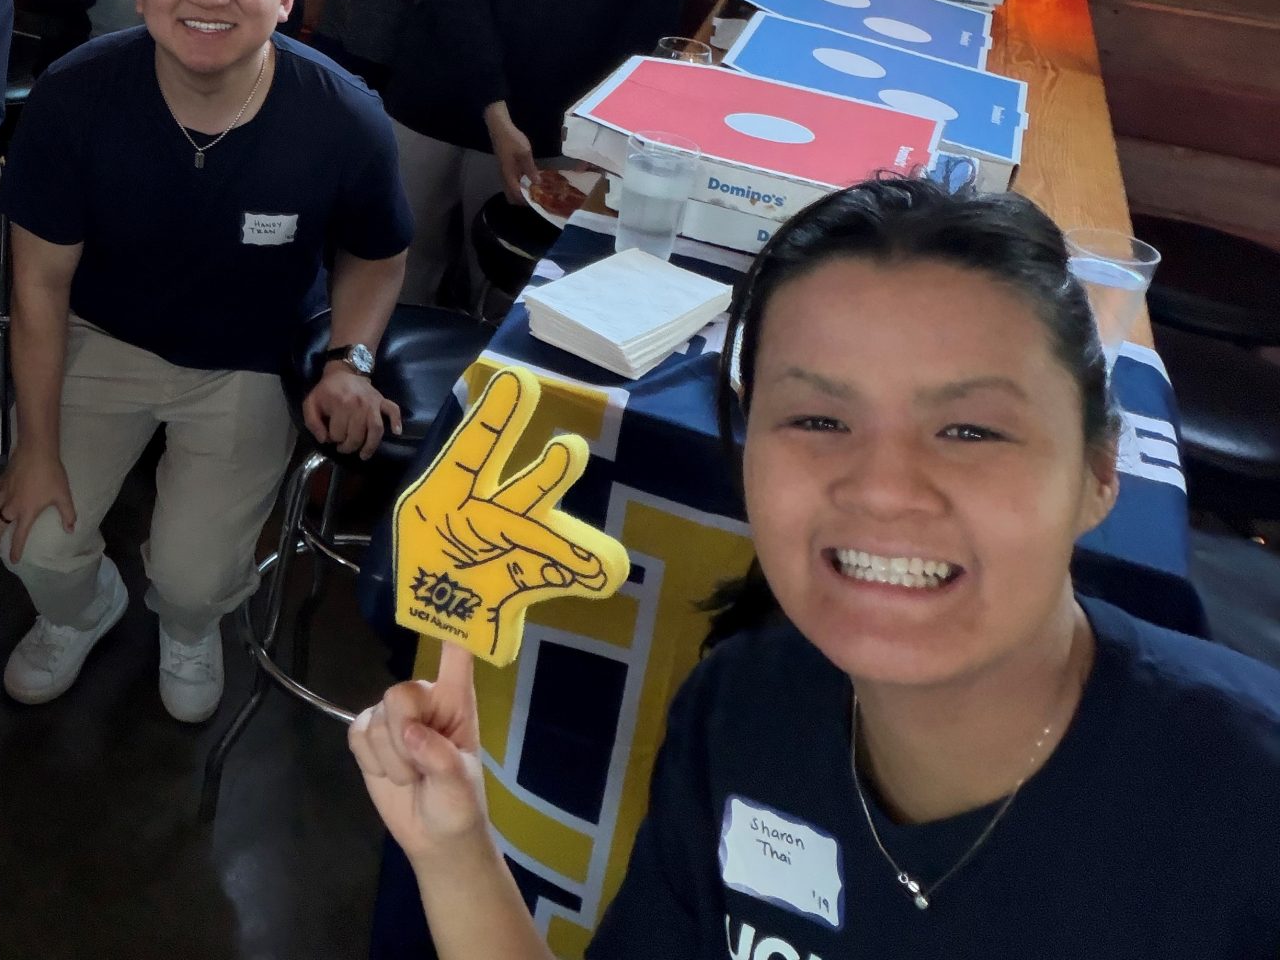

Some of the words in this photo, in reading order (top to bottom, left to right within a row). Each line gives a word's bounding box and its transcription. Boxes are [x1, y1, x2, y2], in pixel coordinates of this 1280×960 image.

[707, 176, 786, 208] Domino's
[408, 606, 430, 622] UCI
[430, 616, 469, 640] Alumni
[749, 817, 806, 851] Sharon
[755, 838, 792, 866] Thai
